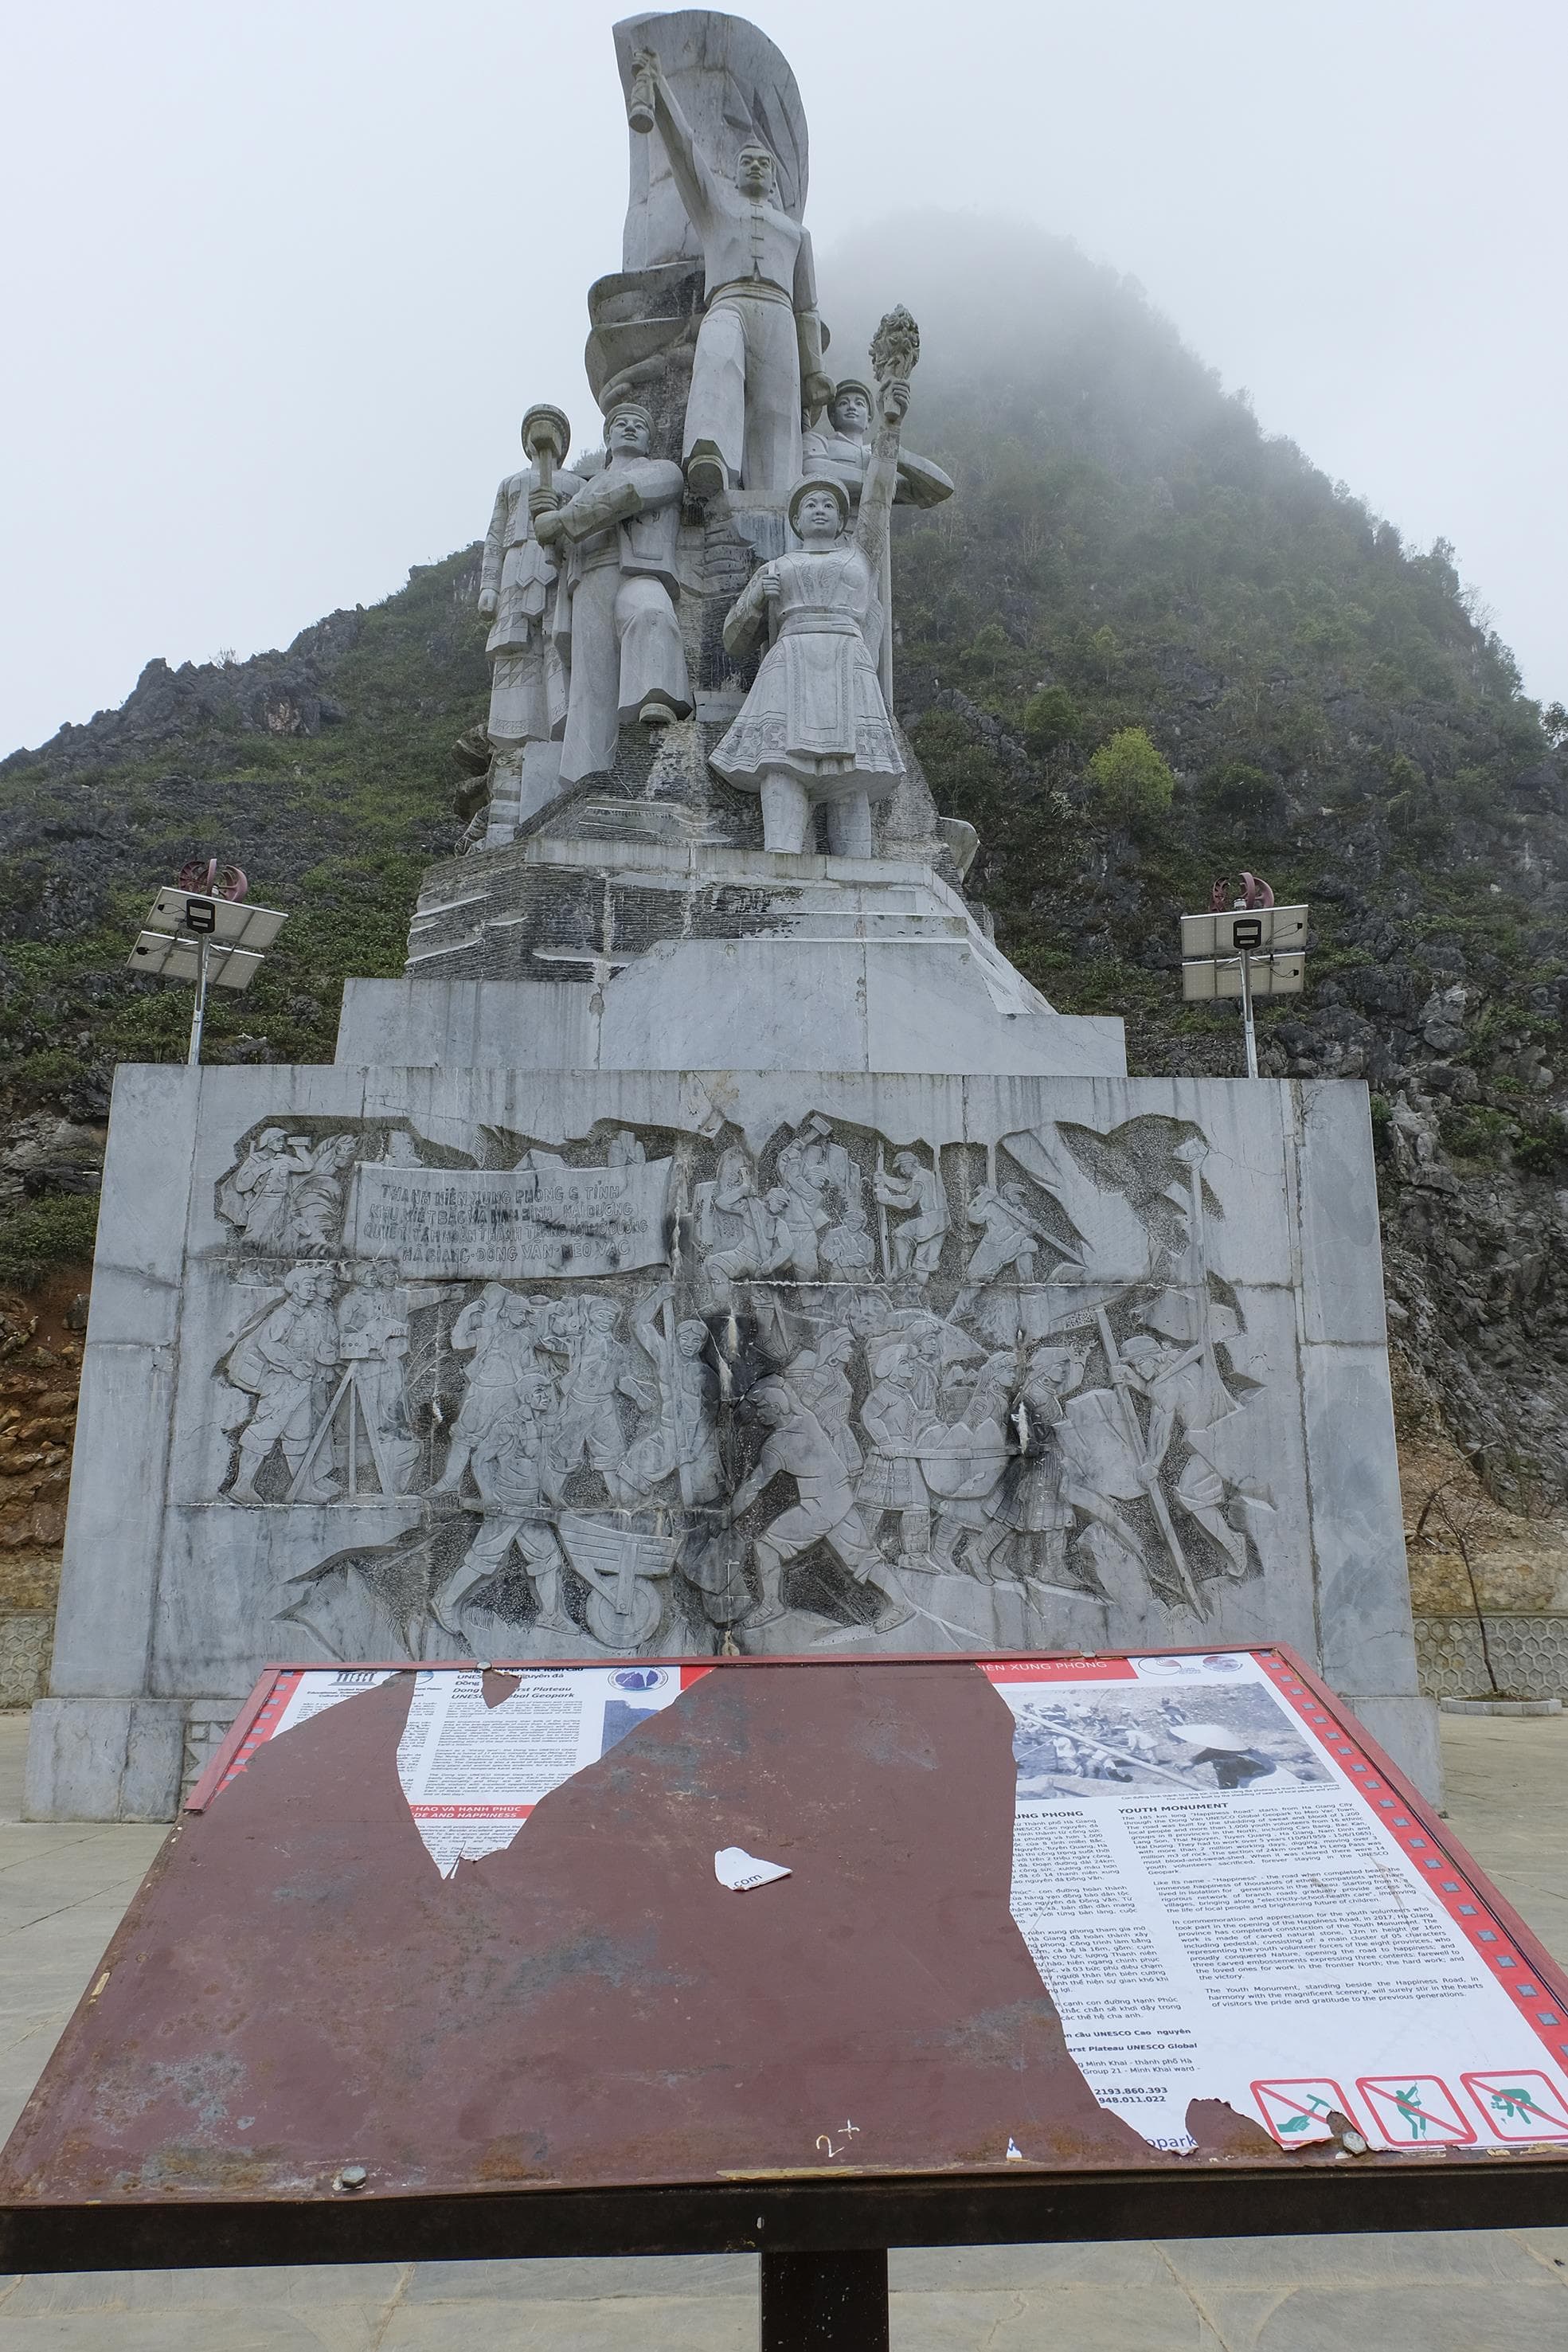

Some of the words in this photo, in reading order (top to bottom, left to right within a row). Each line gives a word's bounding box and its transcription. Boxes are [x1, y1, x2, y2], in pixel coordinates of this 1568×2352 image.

[381, 1184, 431, 1205] THANH
[435, 1187, 467, 1206] NIÊN
[472, 1189, 511, 1206] XUNG
[515, 1186, 564, 1204] PHONG
[370, 1203, 398, 1221] KHU
[1161, 1802, 1229, 1812] MONUMENT
[733, 1874, 763, 1888] .com
[1284, 1990, 1333, 1998] magnificent
[1312, 1995, 1350, 2004] gratitude
